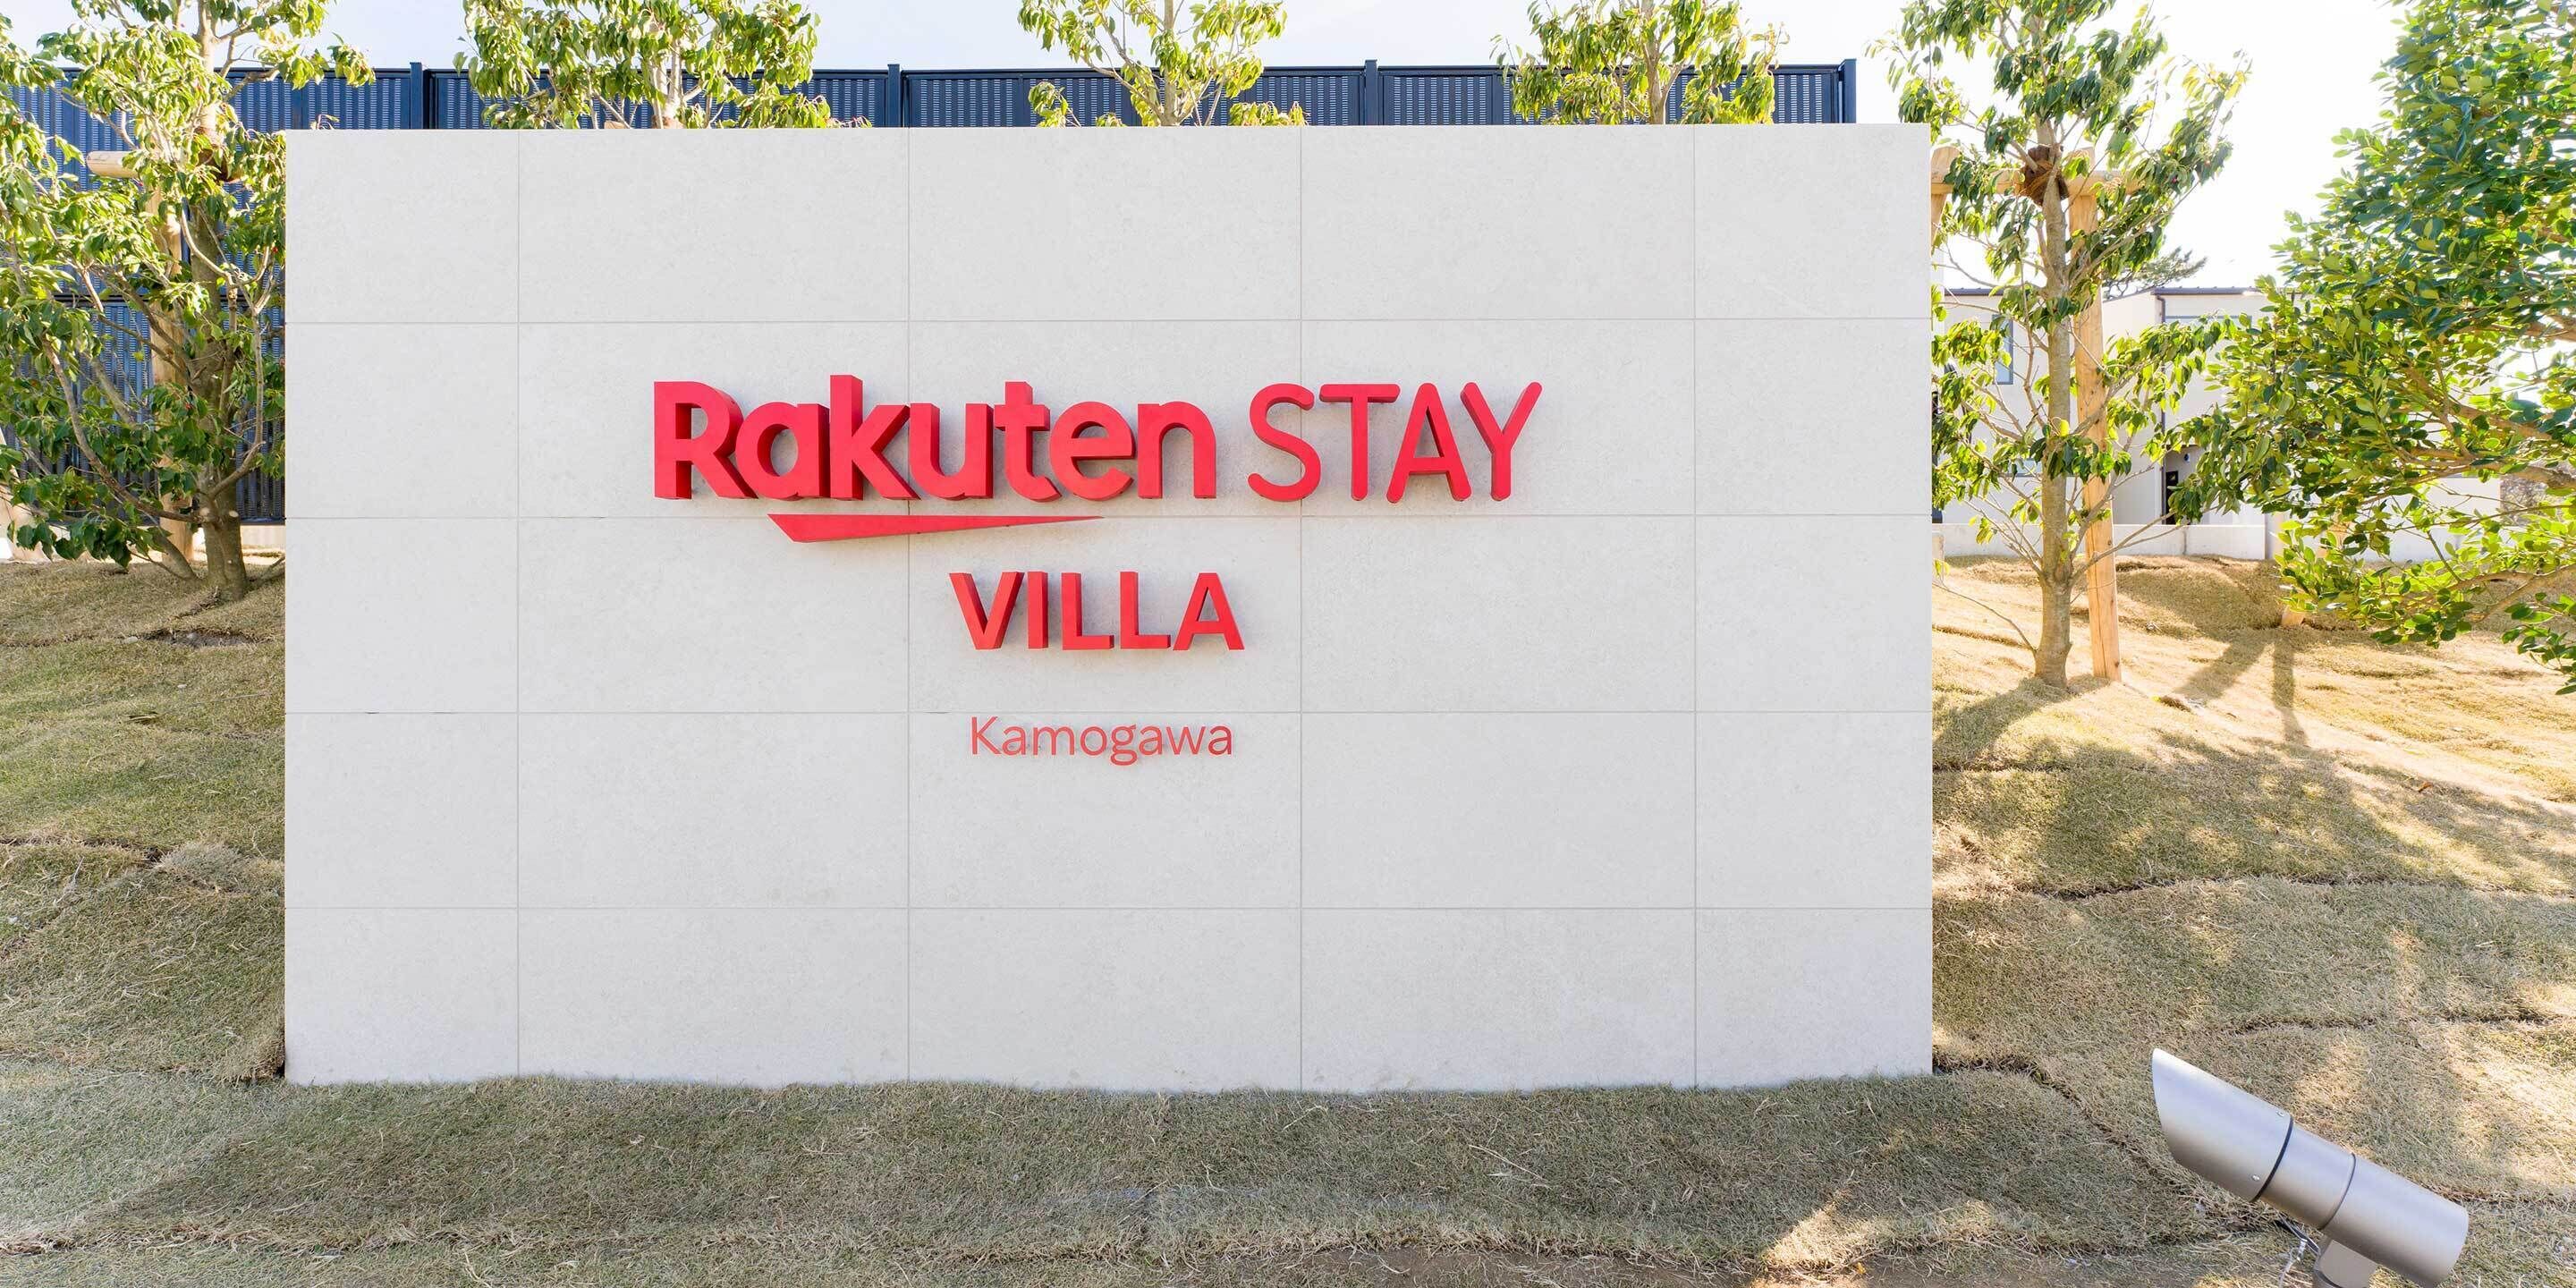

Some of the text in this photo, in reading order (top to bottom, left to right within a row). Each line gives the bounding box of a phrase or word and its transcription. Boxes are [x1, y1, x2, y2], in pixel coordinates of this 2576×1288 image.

[653, 373, 1544, 504] Rakuten STAY
[948, 570, 1246, 653] VILLA
[970, 716, 1233, 767] Kamogawa
